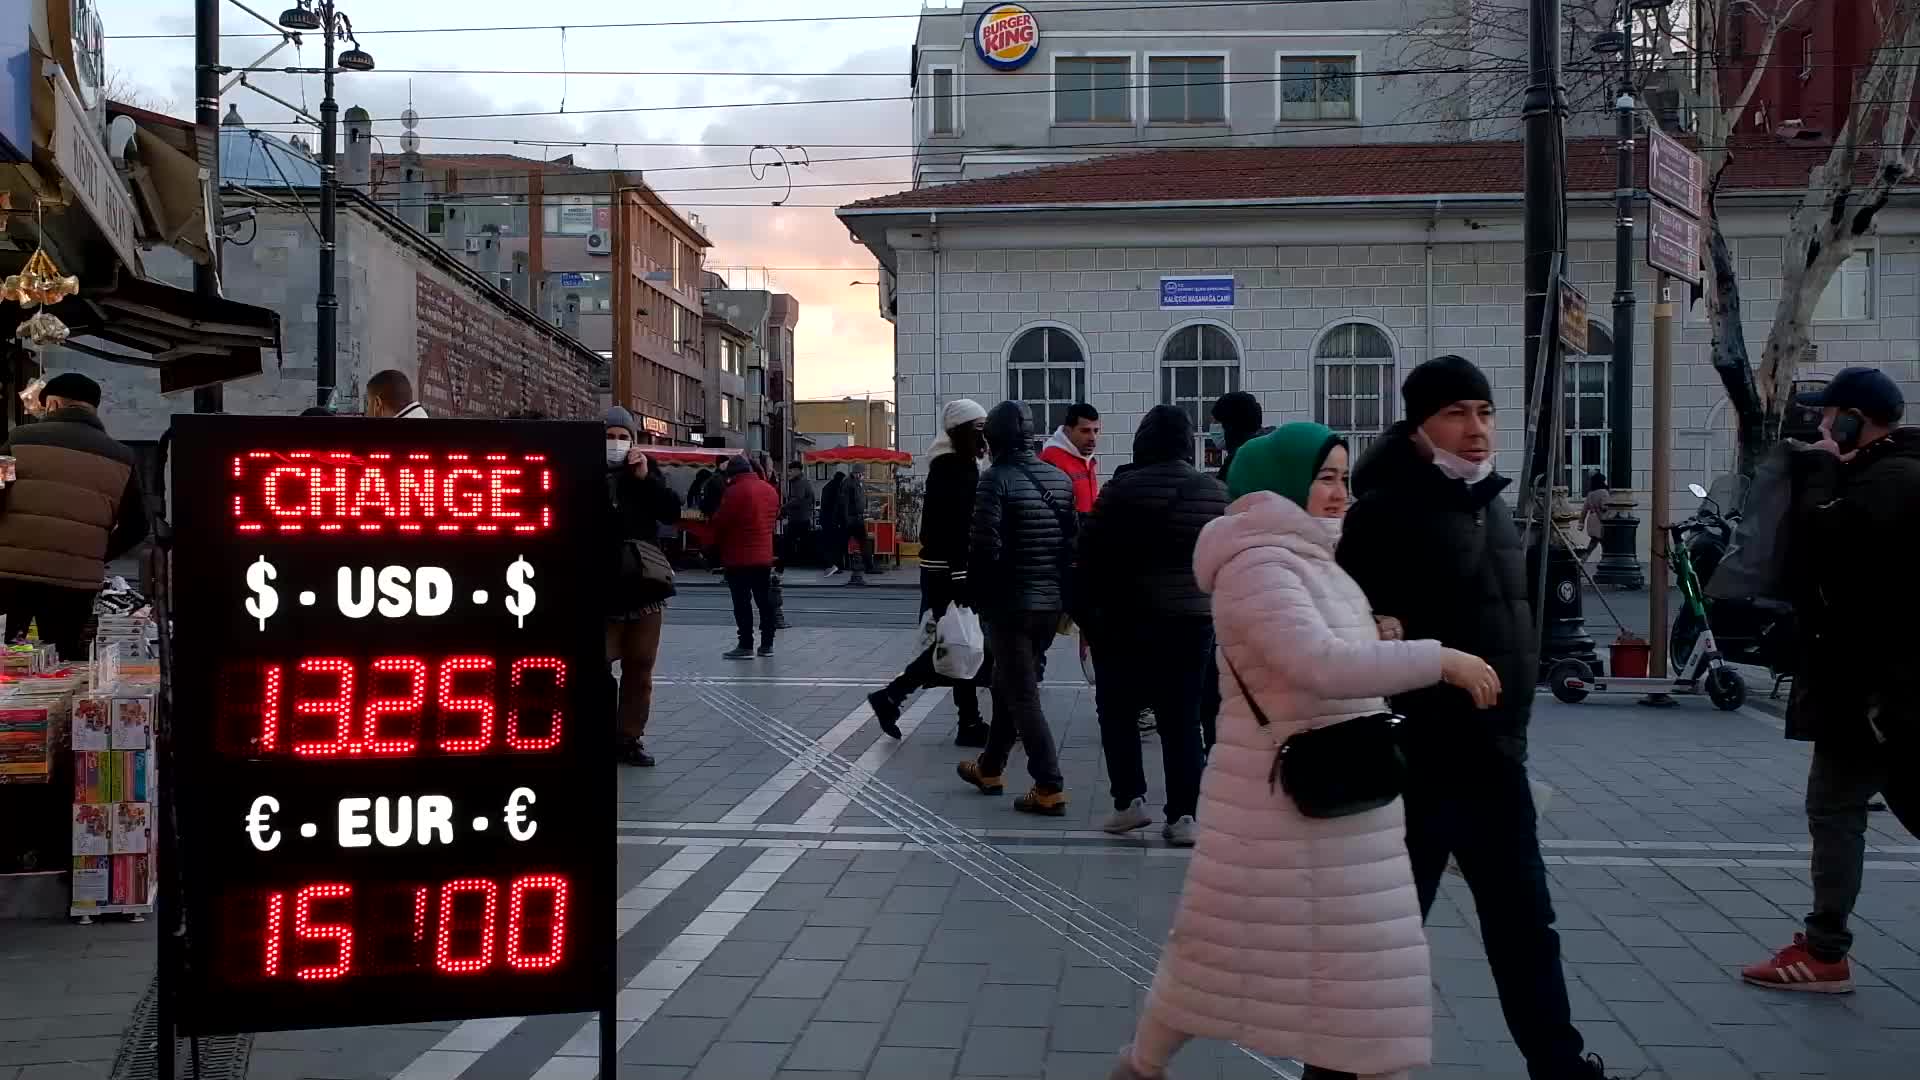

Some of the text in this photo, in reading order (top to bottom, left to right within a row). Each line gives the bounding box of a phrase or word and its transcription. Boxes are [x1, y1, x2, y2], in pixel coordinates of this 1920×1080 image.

[983, 15, 1032, 39] BURGER
[985, 26, 1034, 55] KING
[264, 466, 522, 518] CHANGE
[245, 554, 279, 632] $
[337, 565, 454, 619] USD
[504, 554, 537, 629] $
[244, 795, 282, 852] €
[338, 795, 454, 848] EUR
[503, 786, 538, 842] €
